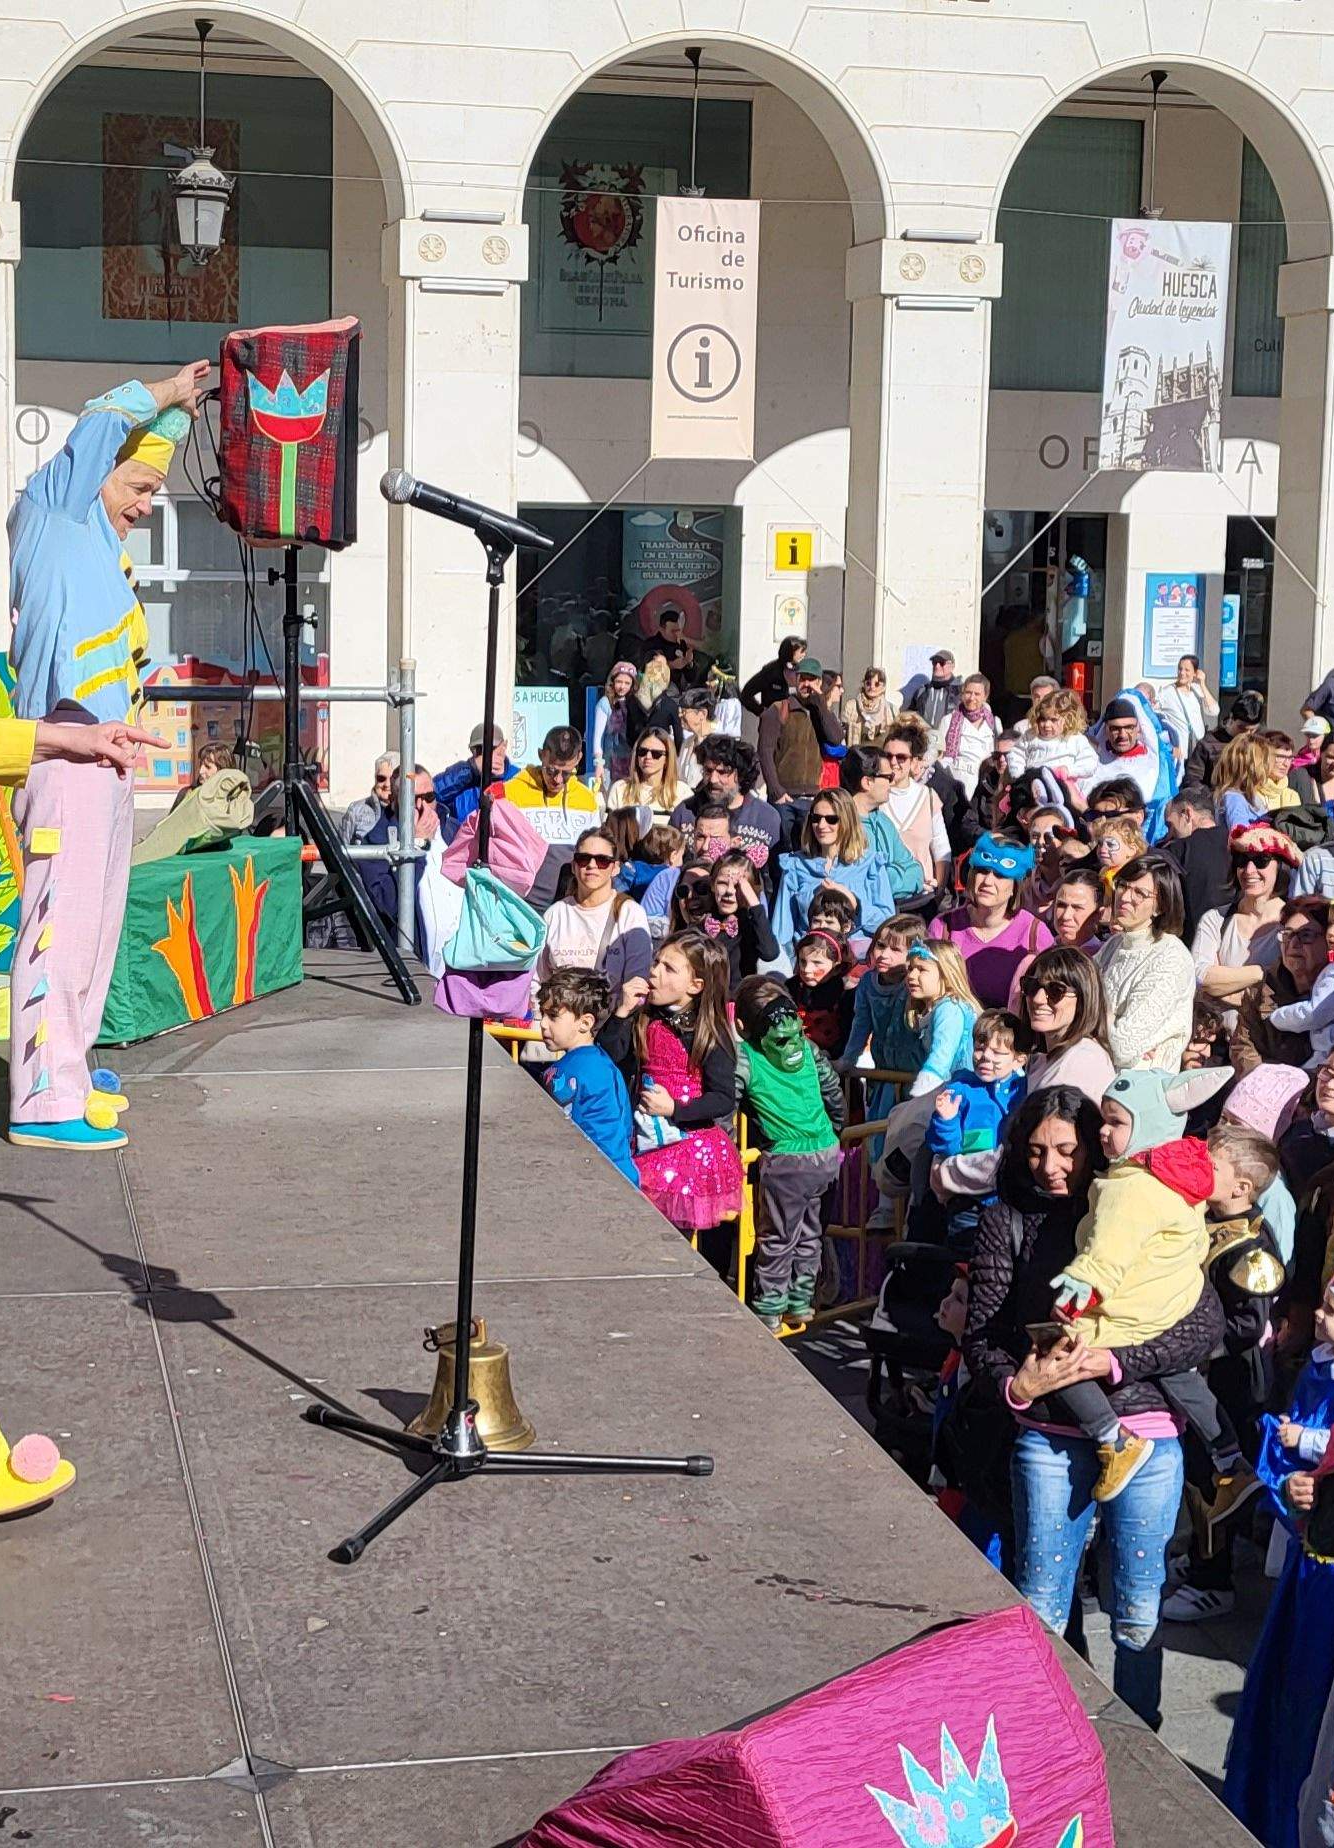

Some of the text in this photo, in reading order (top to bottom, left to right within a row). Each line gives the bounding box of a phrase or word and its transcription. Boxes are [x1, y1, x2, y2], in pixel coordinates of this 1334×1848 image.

[677, 225, 745, 243] Oficina
[721, 249, 745, 267] de
[666, 271, 744, 291] Turismo
[1162, 271, 1218, 300] HUESCA
[1128, 296, 1219, 324] Ciudad de leyendas
[530, 691, 566, 703] HUESCA
